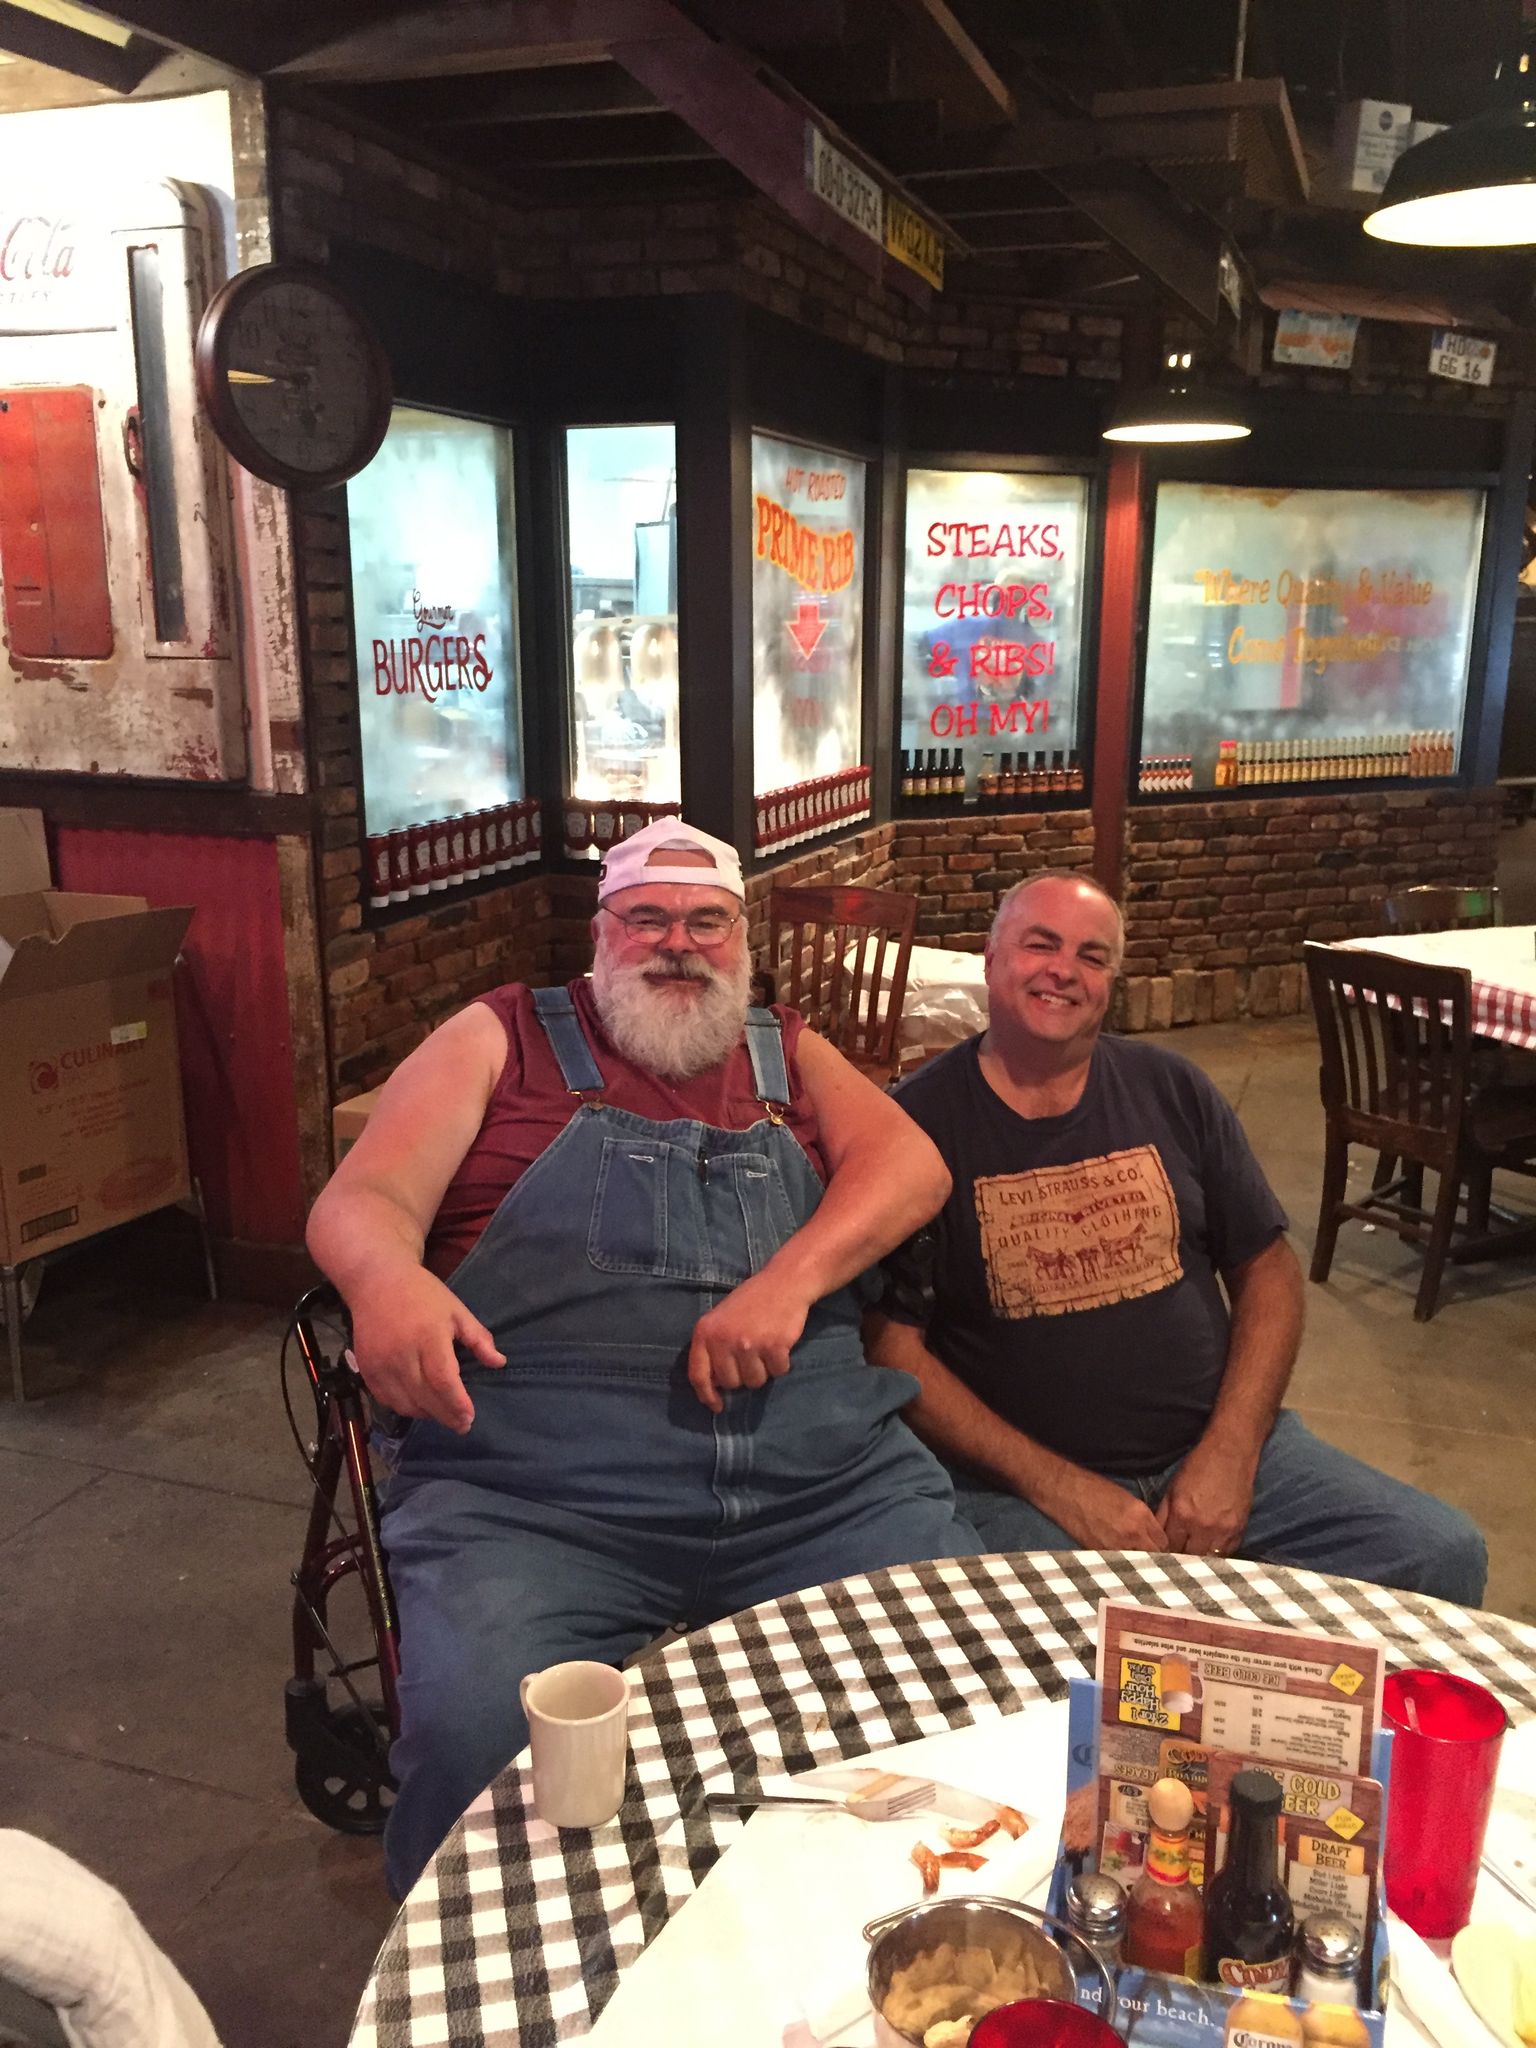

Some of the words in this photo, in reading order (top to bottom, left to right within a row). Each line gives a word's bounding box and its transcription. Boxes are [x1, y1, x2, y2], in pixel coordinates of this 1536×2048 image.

[1463, 361, 1481, 380] 16
[756, 494, 819, 592] PRIME
[820, 529, 854, 593] RIB
[927, 522, 1064, 560] STEAKS,
[1359, 567, 1373, 602] &
[934, 581, 1053, 620] CHOPS,
[372, 633, 493, 703] BURGERS
[928, 640, 959, 677] &
[969, 641, 1056, 677] RIBS!
[930, 702, 978, 737] OH
[988, 700, 1050, 735] MY!
[999, 1189, 1033, 1206] LEVI
[1038, 1177, 1098, 1200] STRAUSS
[1103, 1175, 1114, 1188] &
[1117, 1167, 1144, 1184] CO.
[998, 1227, 1071, 1249] QUALITY
[1081, 1205, 1162, 1237] CLOTHING
[1203, 1663, 1231, 1679] BEER
[1232, 1668, 1261, 1683] COLD
[1262, 1672, 1281, 1686] ICE
[1120, 1689, 1160, 1711] Happy
[1125, 1681, 1156, 1698] Hour
[1138, 1709, 1158, 1724] for
[1158, 1712, 1169, 1726] 2
[1290, 1774, 1341, 1801] COLD
[1282, 1794, 1319, 1817] EER
[1312, 1839, 1351, 1858] DRAFT
[1316, 1853, 1346, 1870] BEER
[1080, 1986, 1102, 2003] nd
